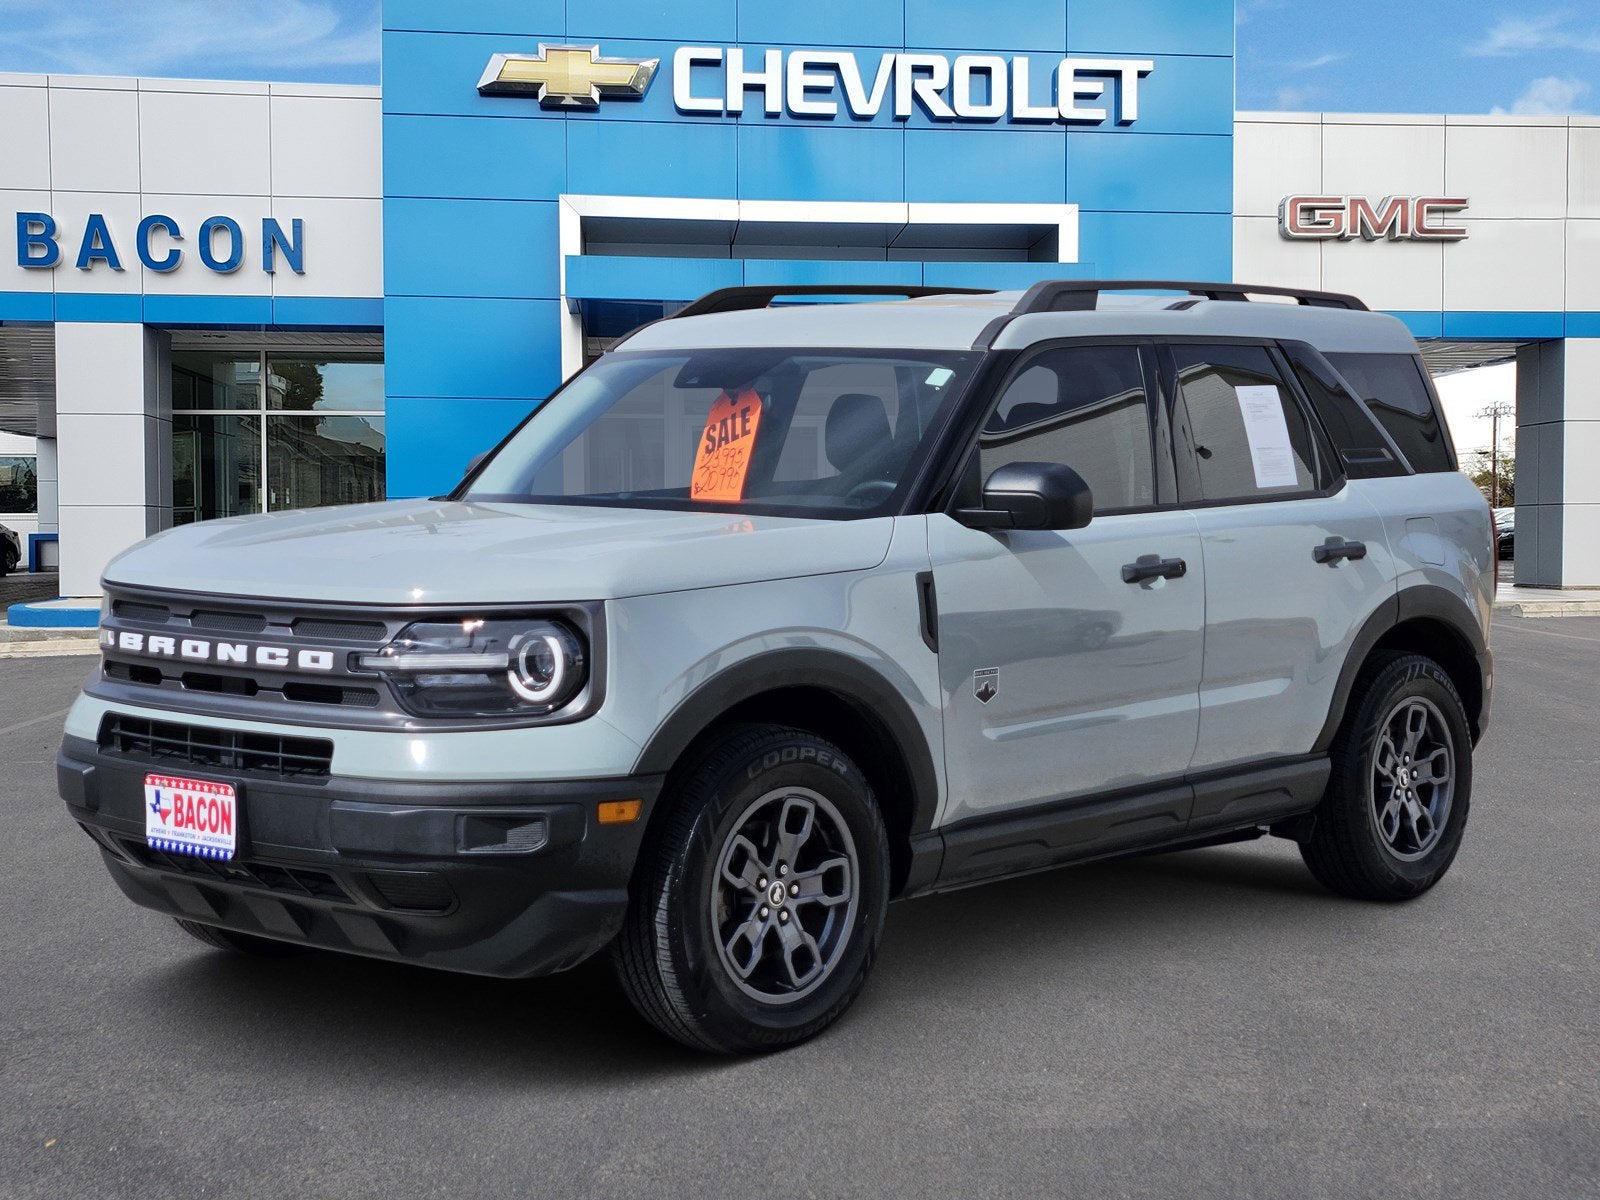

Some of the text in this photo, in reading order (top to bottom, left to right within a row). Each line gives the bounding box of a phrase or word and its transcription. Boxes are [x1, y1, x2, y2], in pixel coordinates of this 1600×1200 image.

[673, 46, 1155, 125] CHEVROLET
[1279, 194, 1469, 241] GMC
[16, 211, 305, 275] BACON
[705, 405, 751, 455] SALE
[119, 631, 334, 670] BRONCO
[747, 746, 848, 779] COOPER
[173, 793, 232, 836] BACON
